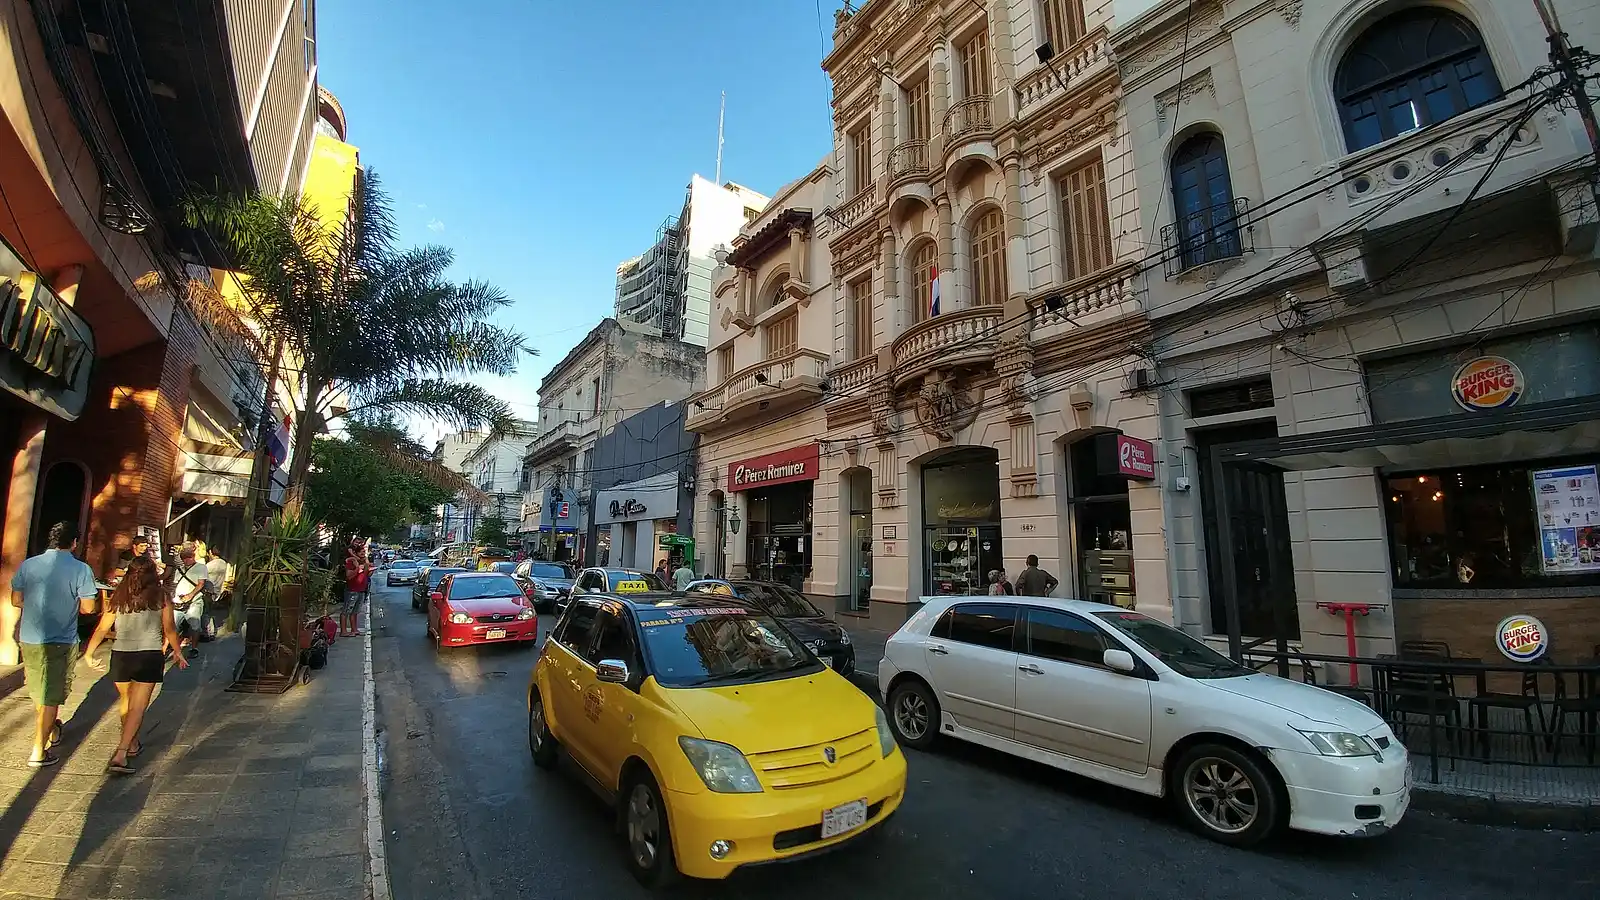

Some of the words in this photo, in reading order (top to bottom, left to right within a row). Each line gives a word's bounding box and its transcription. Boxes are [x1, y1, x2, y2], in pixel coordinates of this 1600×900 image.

[1459, 364, 1511, 389] BURGER
[1463, 373, 1515, 402] KING
[1131, 445, 1146, 459] Pérez
[744, 467, 767, 484] Pérez
[767, 461, 804, 480] Ramírez
[1132, 457, 1153, 473] Ramírez
[640, 619, 670, 627] PARADA
[1503, 624, 1538, 641] BURGER
[1506, 631, 1541, 651] KING
